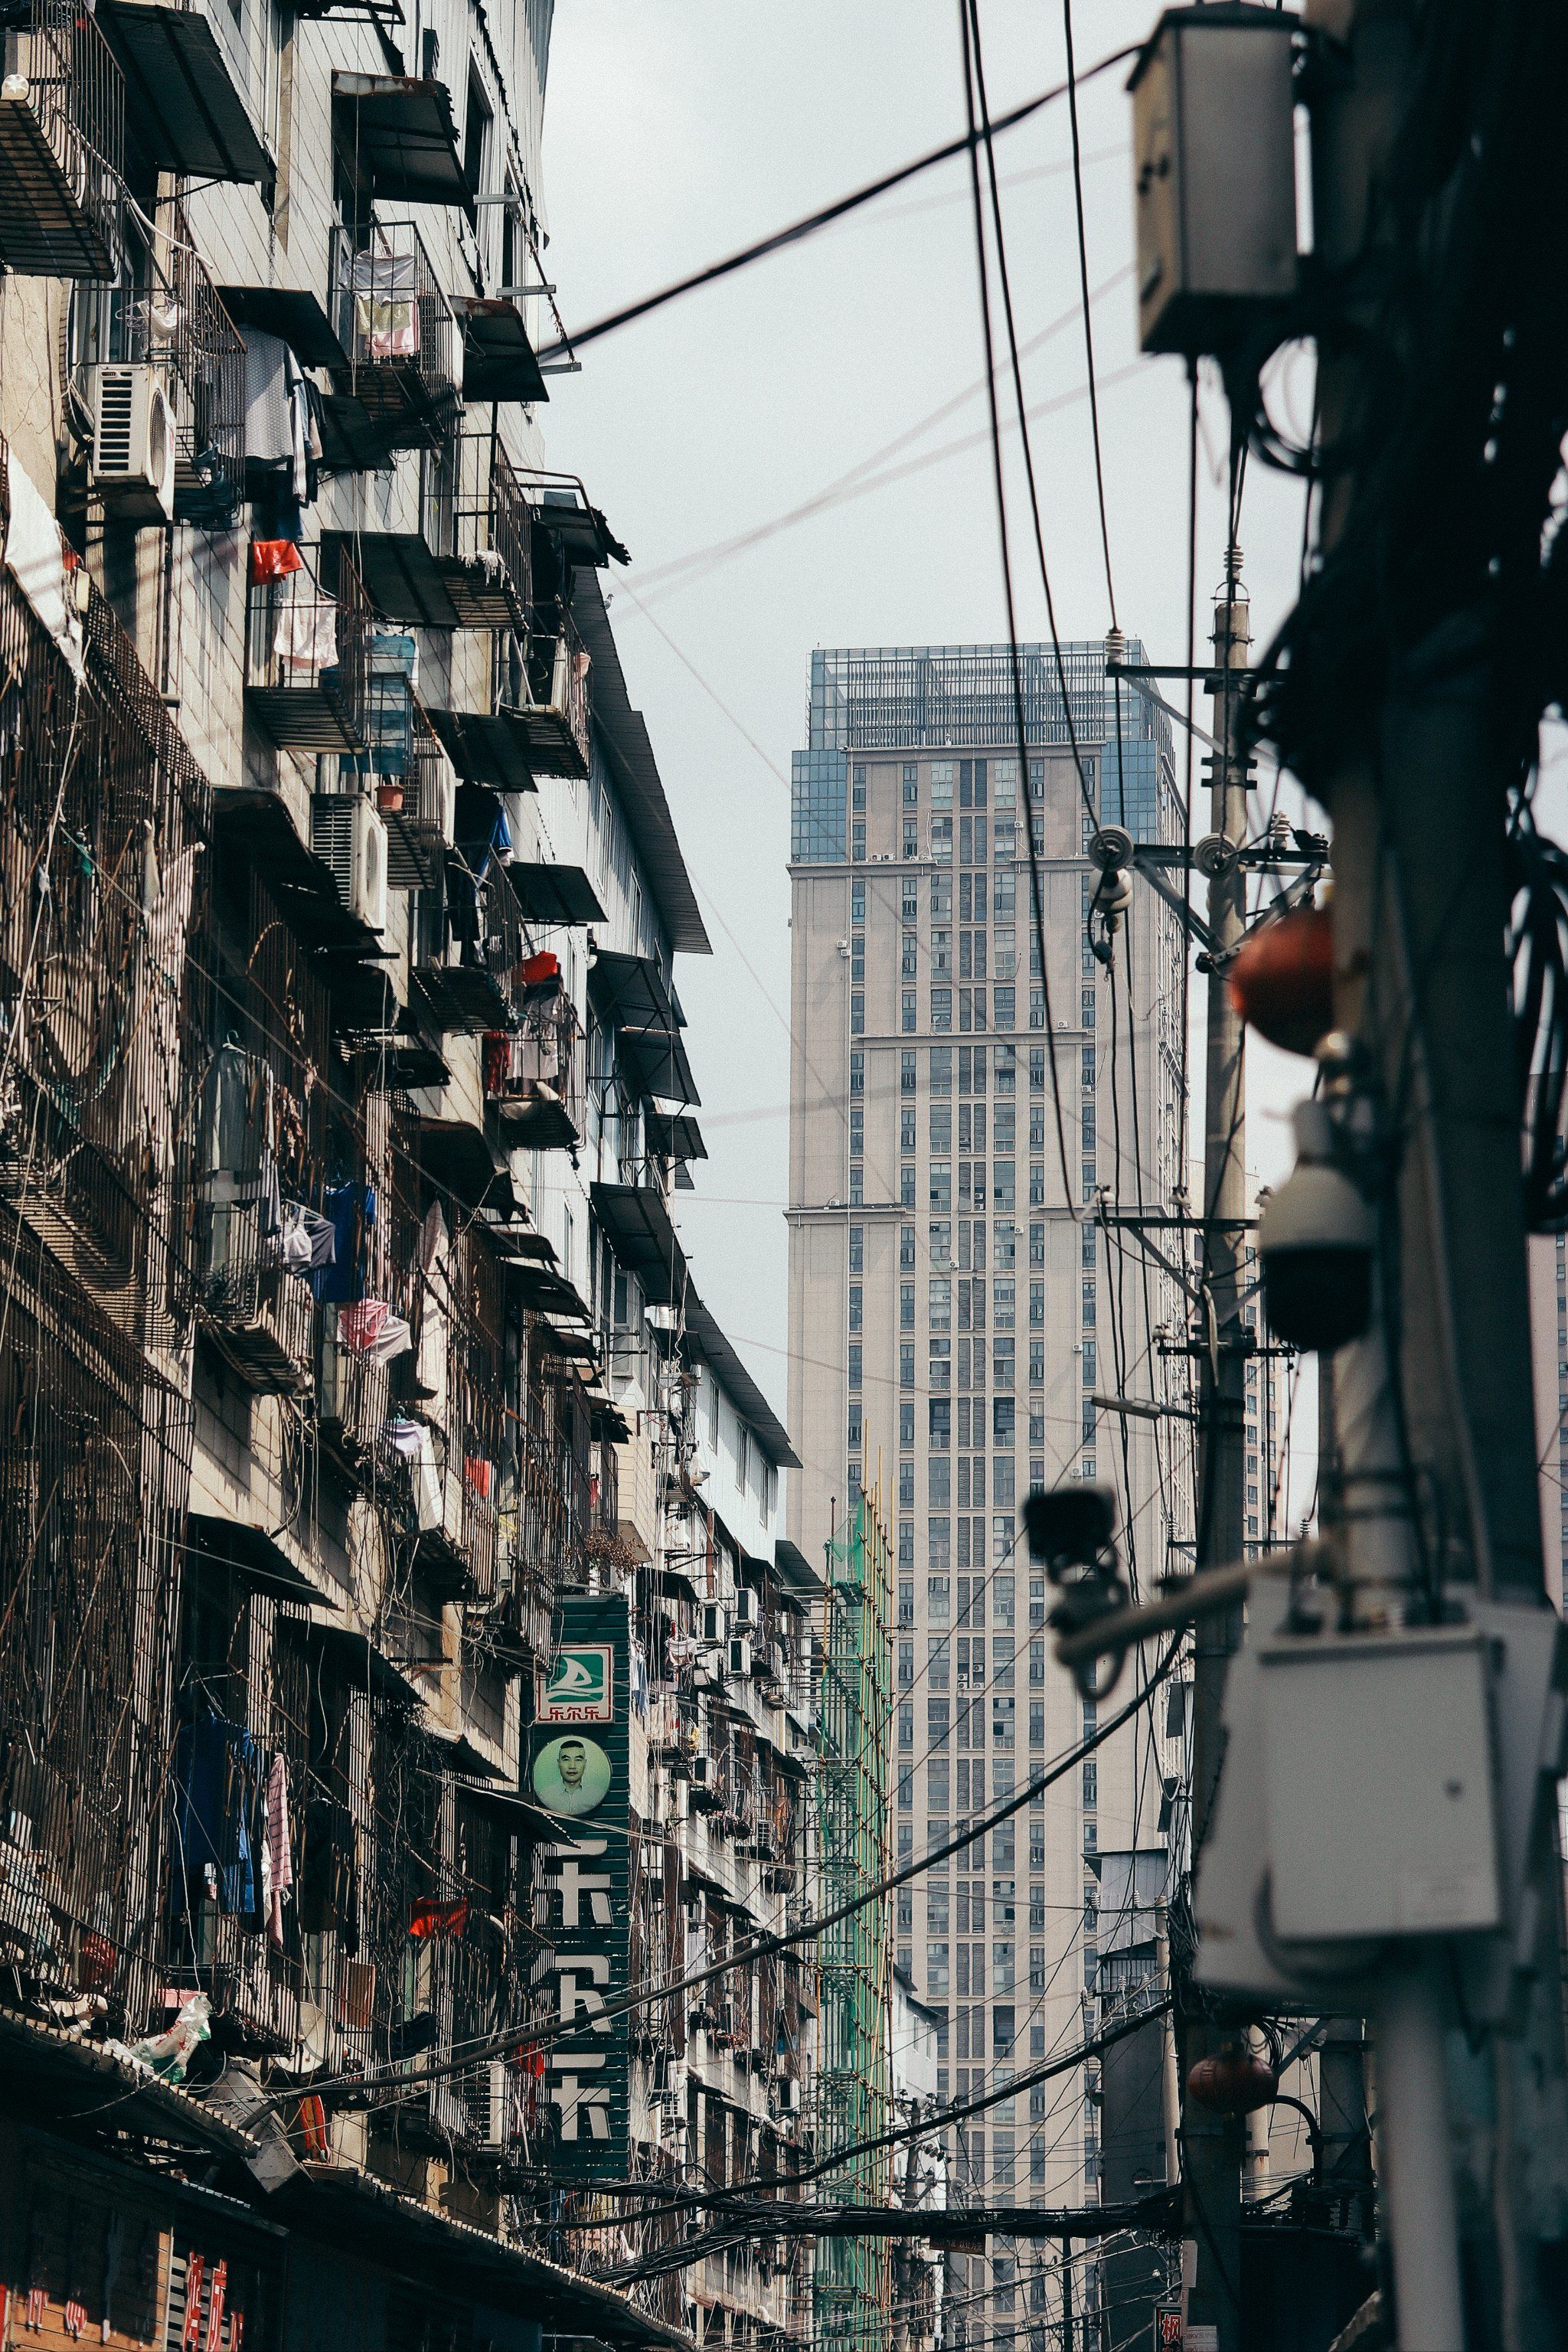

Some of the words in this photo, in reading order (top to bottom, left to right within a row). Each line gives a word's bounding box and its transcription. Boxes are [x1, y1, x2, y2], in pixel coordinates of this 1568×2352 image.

[550, 1706, 599, 1721] 乐尔乐
[534, 1839, 613, 2141] 乐尔乐
[1161, 2313, 1181, 2352] 枫
